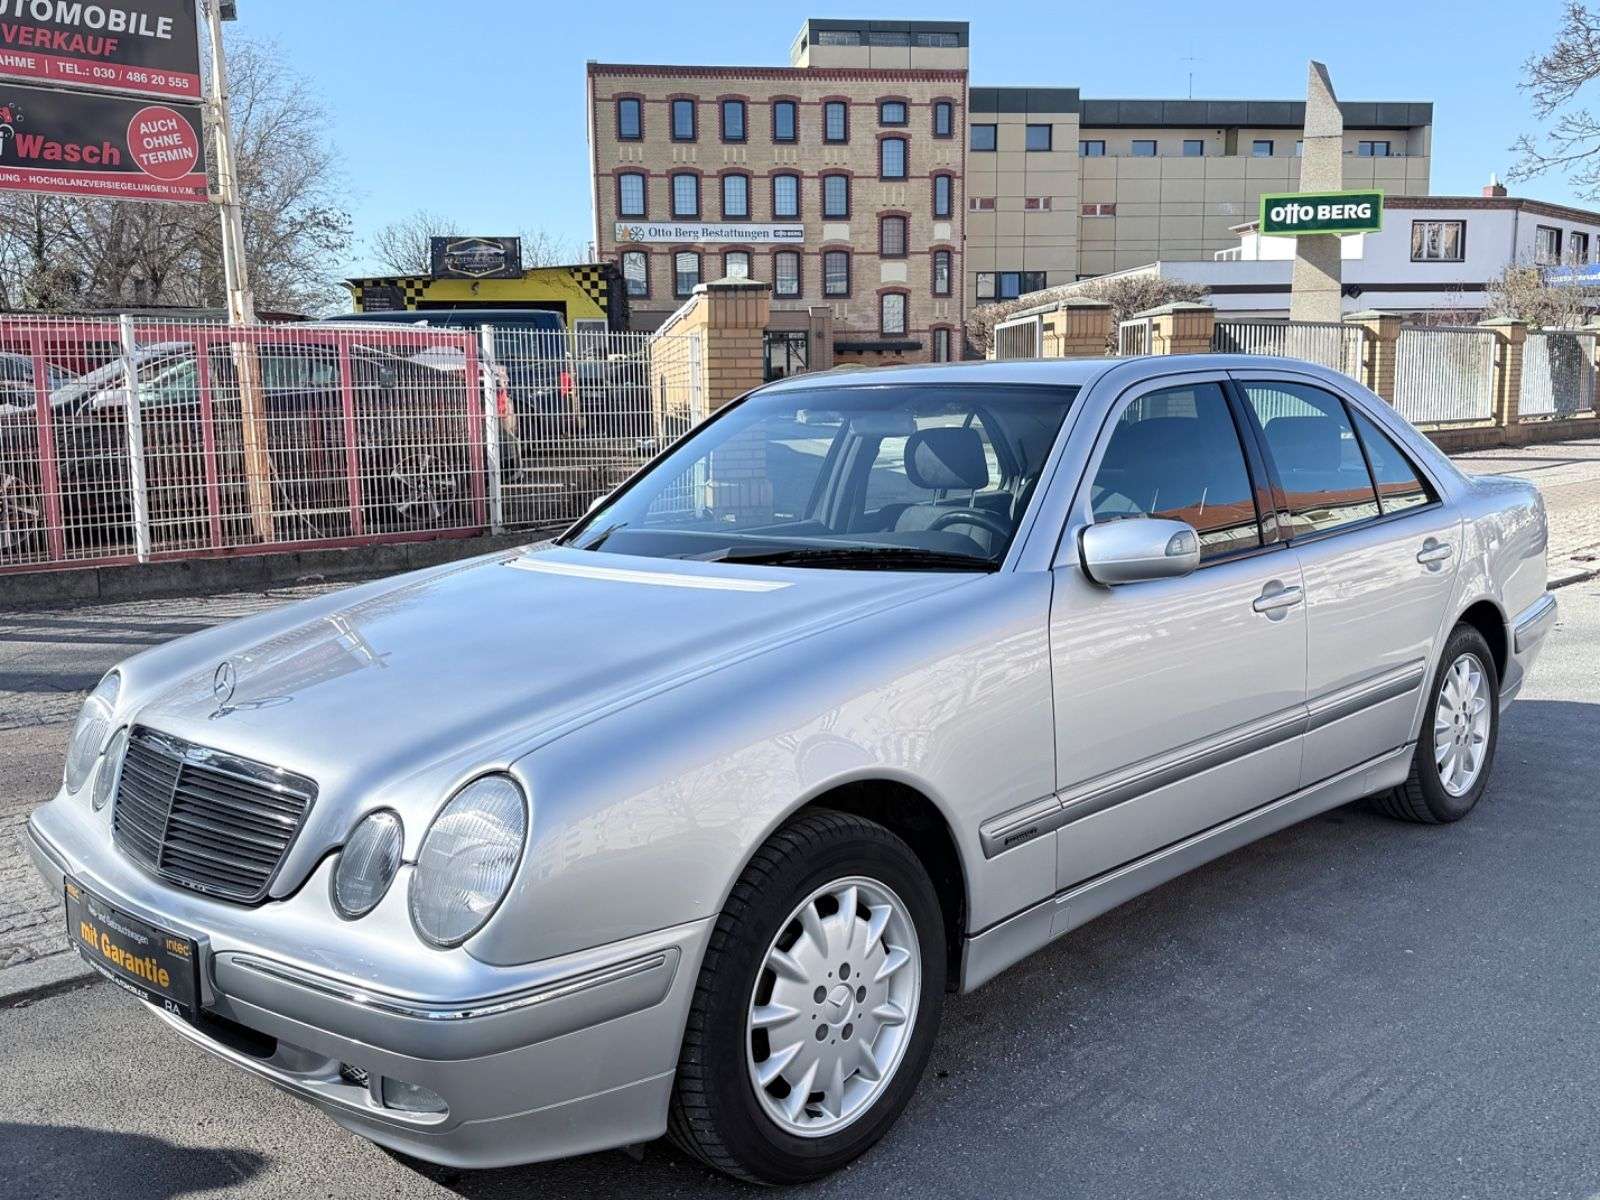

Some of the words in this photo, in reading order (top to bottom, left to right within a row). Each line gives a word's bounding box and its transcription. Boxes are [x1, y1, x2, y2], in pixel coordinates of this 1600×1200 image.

[2, 23, 119, 56] VERKAUF
[57, 62, 90, 76] TEL.:
[93, 66, 115, 79] 030
[126, 71, 148, 83] 486
[151, 75, 165, 85] 20
[168, 77, 189, 88] 555
[139, 118, 178, 135] AUCH
[15, 133, 121, 166] Wasch
[143, 134, 183, 150] OHNE
[140, 147, 193, 166] TERMIN
[29, 175, 169, 194] HOCHGLANZVERSIEGELUNGEN
[1317, 204, 1371, 219] BERG
[649, 227, 672, 238] Otto
[675, 227, 699, 241] Berg
[701, 227, 770, 241] Bestattungen
[81, 921, 99, 950] mit
[101, 932, 170, 988] Garantie
